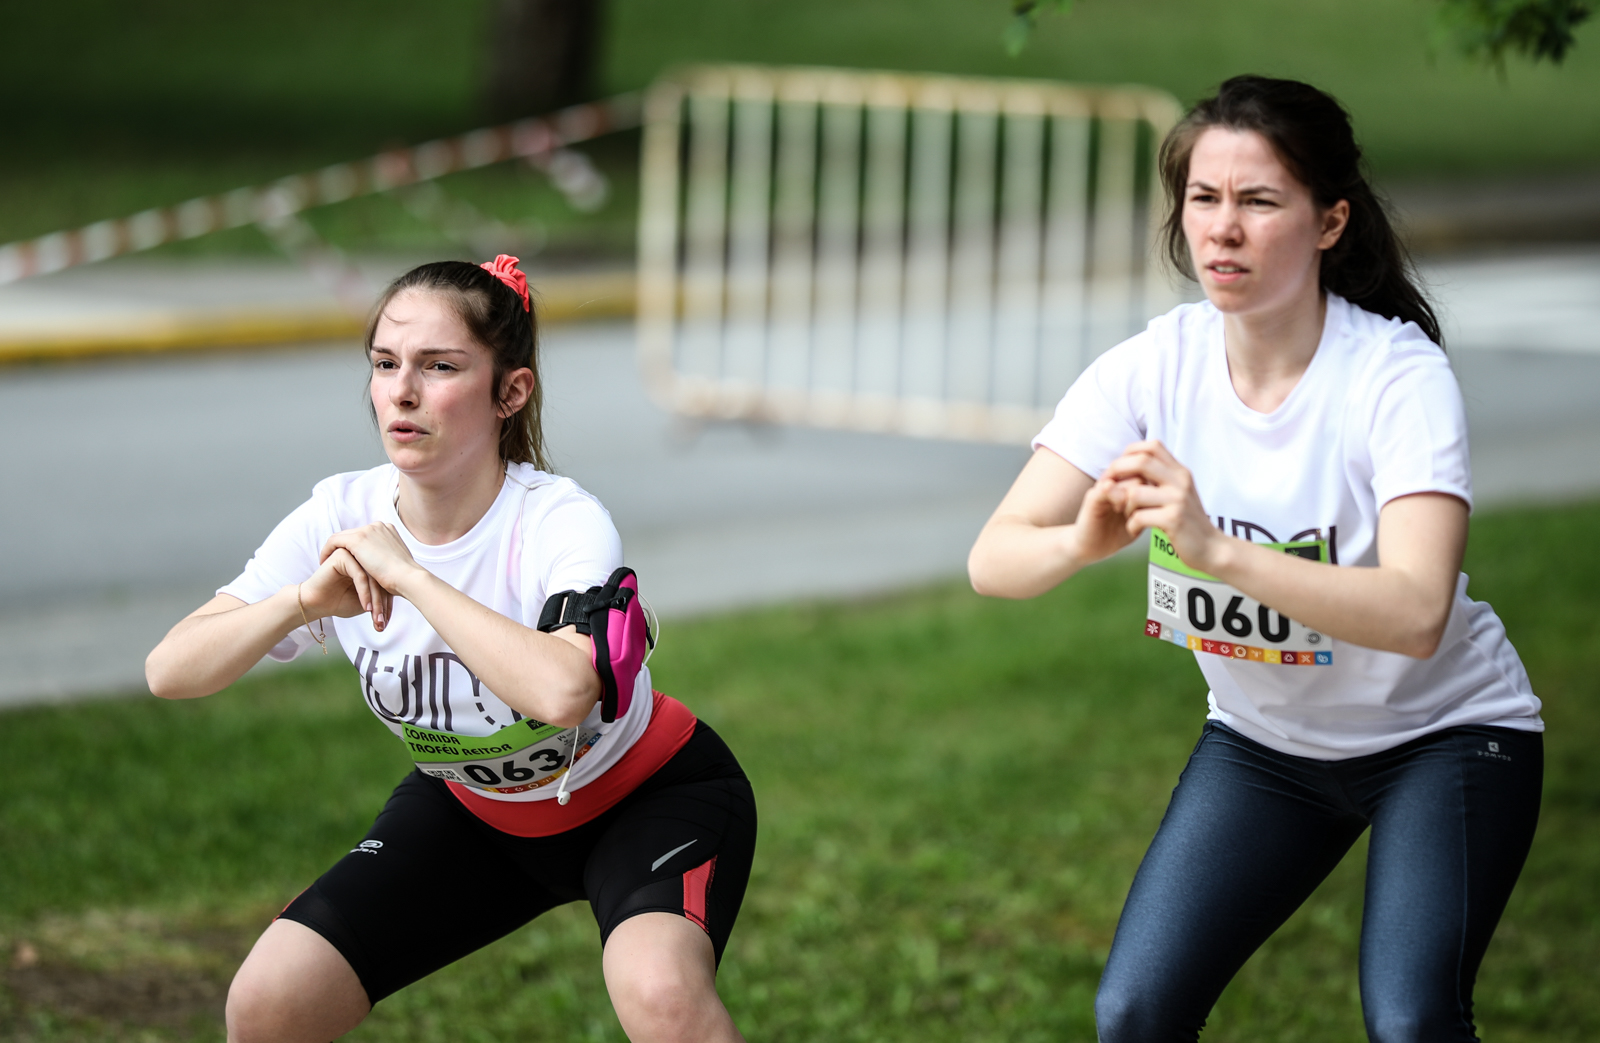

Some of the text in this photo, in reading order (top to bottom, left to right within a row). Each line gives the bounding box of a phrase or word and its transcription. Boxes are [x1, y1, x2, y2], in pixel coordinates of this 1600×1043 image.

[1154, 534, 1179, 559] TRO
[1187, 587, 1290, 643] 060
[404, 727, 461, 745] CORRIDA
[408, 742, 513, 756] TROFÉU REITOR
[463, 748, 566, 785] 063
